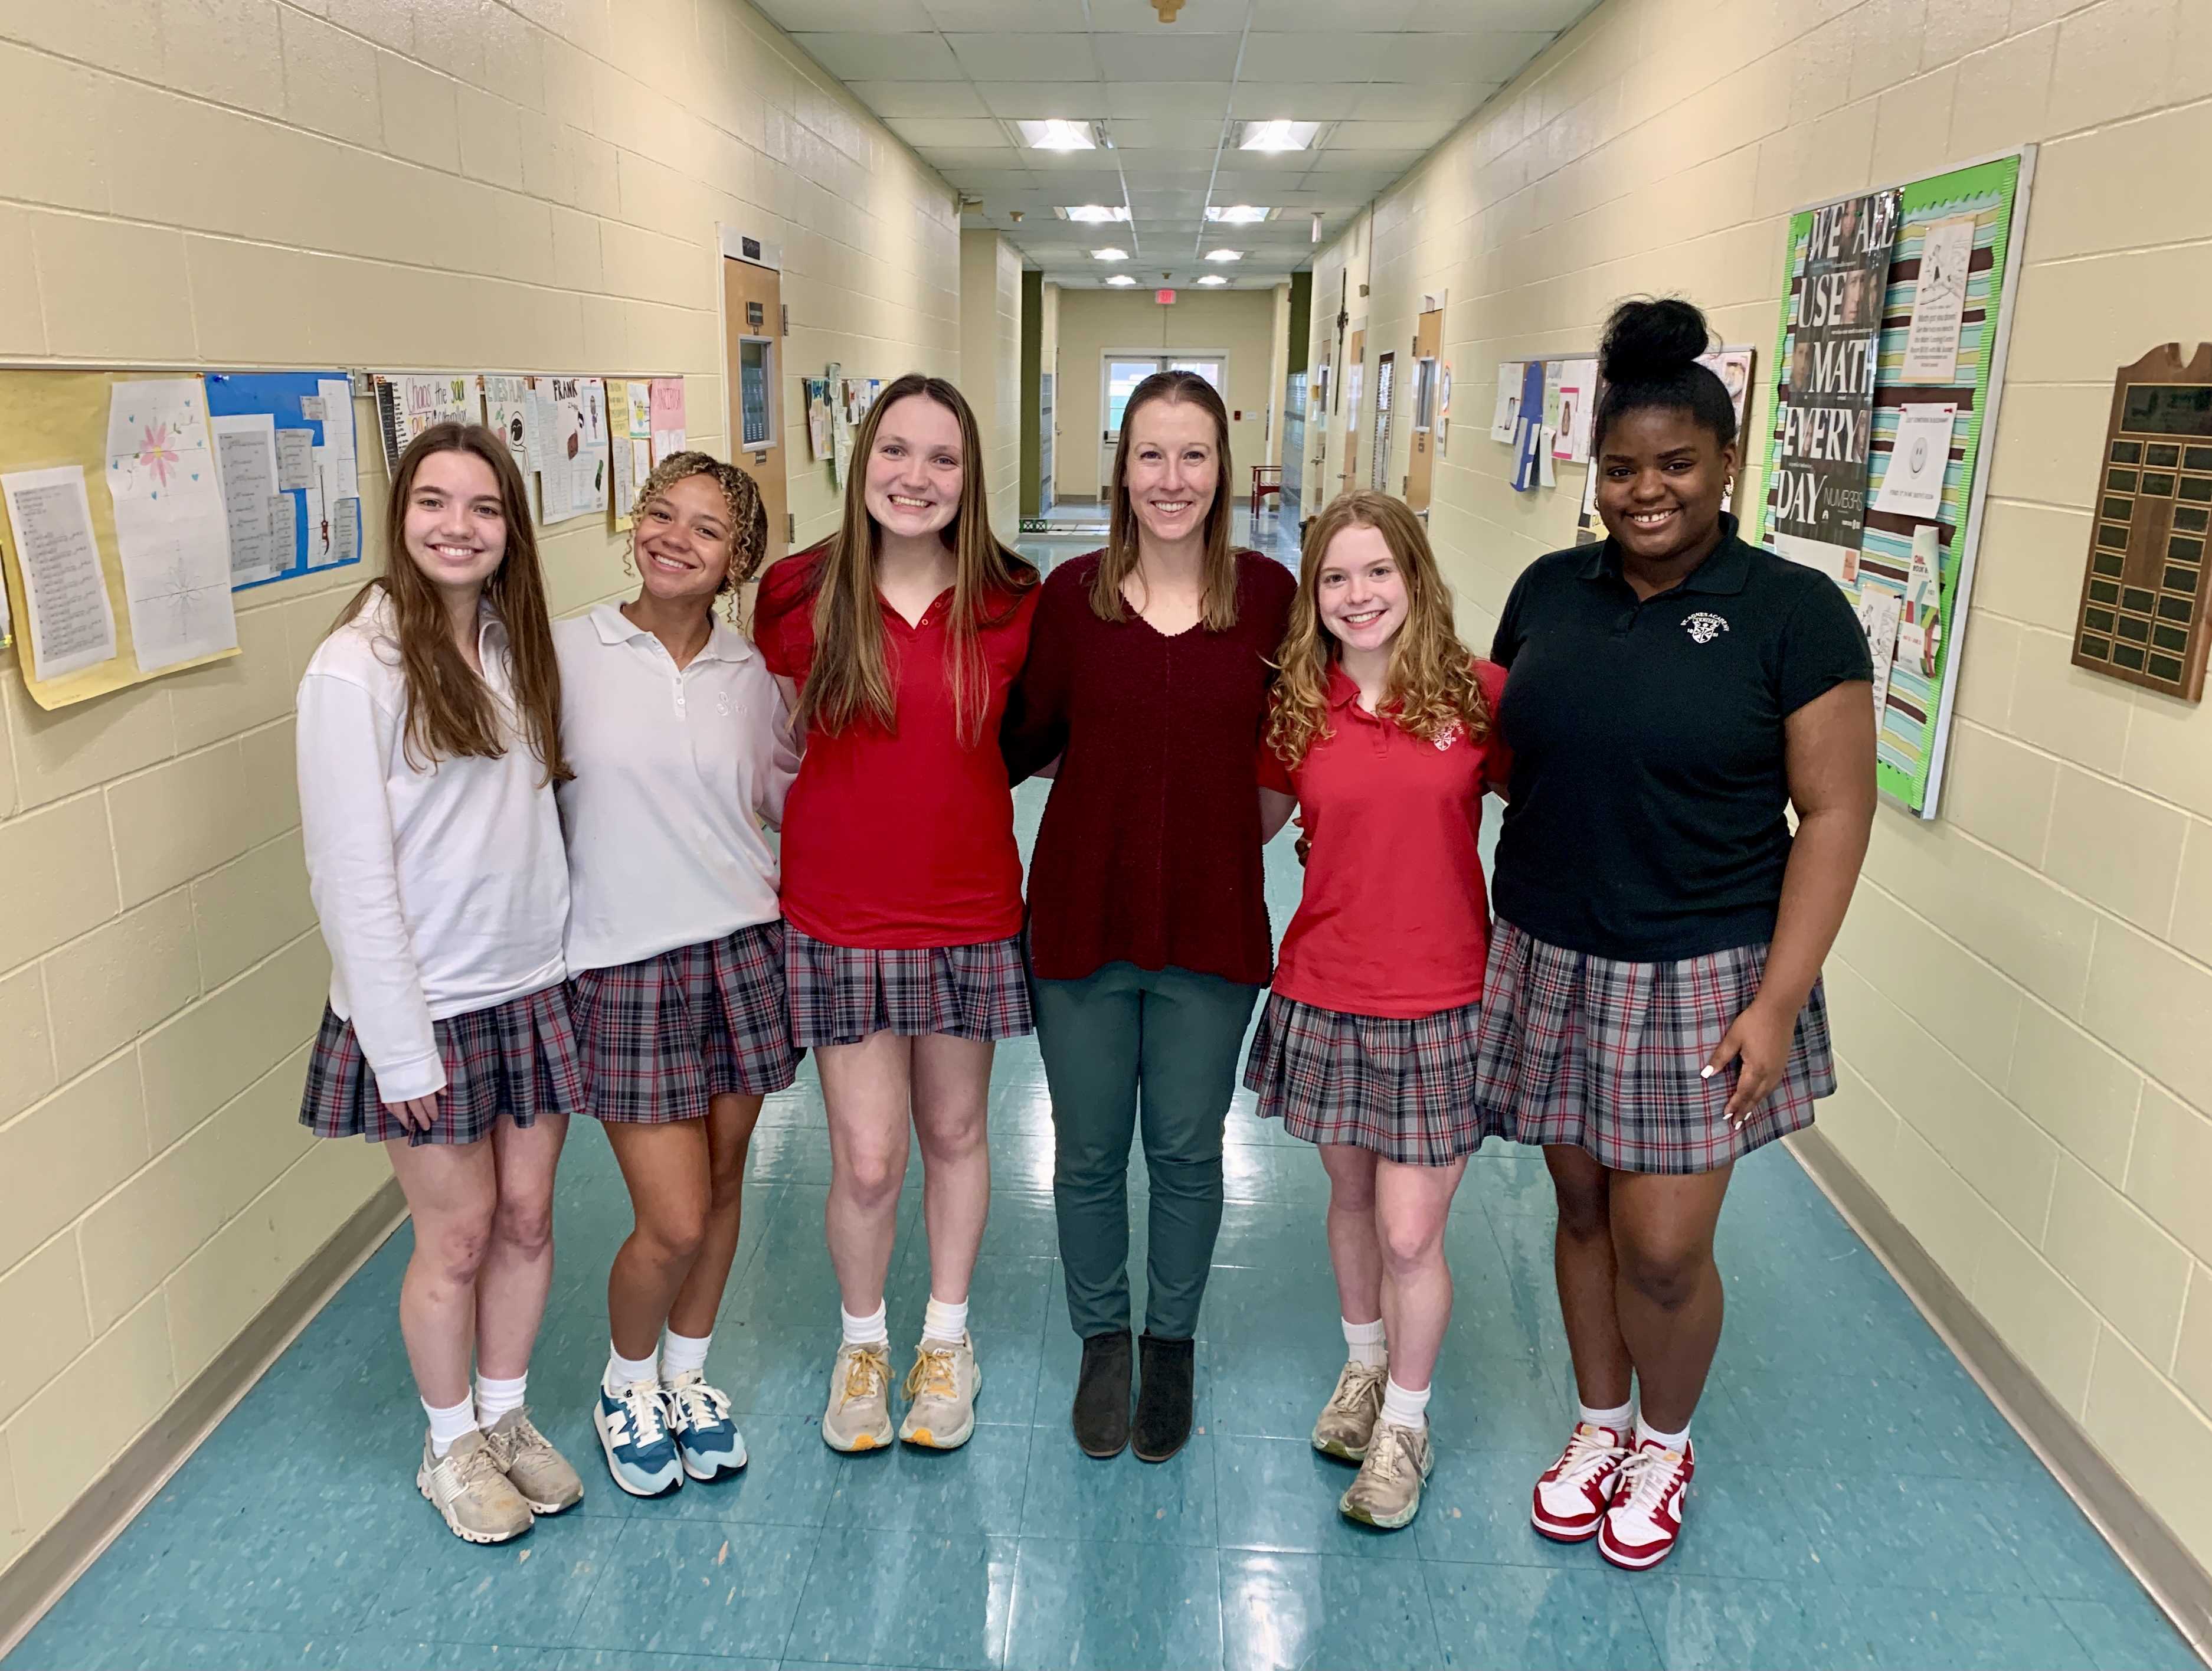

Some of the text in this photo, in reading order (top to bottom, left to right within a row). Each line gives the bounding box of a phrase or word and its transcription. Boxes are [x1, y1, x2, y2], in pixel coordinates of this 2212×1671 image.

[1808, 202, 1845, 262] WE
[1798, 272, 1847, 328] USE
[552, 378, 578, 401] FRANK
[1808, 339, 1879, 394] MATH
[406, 377, 431, 413] Chaos
[435, 381, 447, 406] the
[1782, 407, 1864, 463] EVERY
[1776, 469, 1828, 525] DAY
